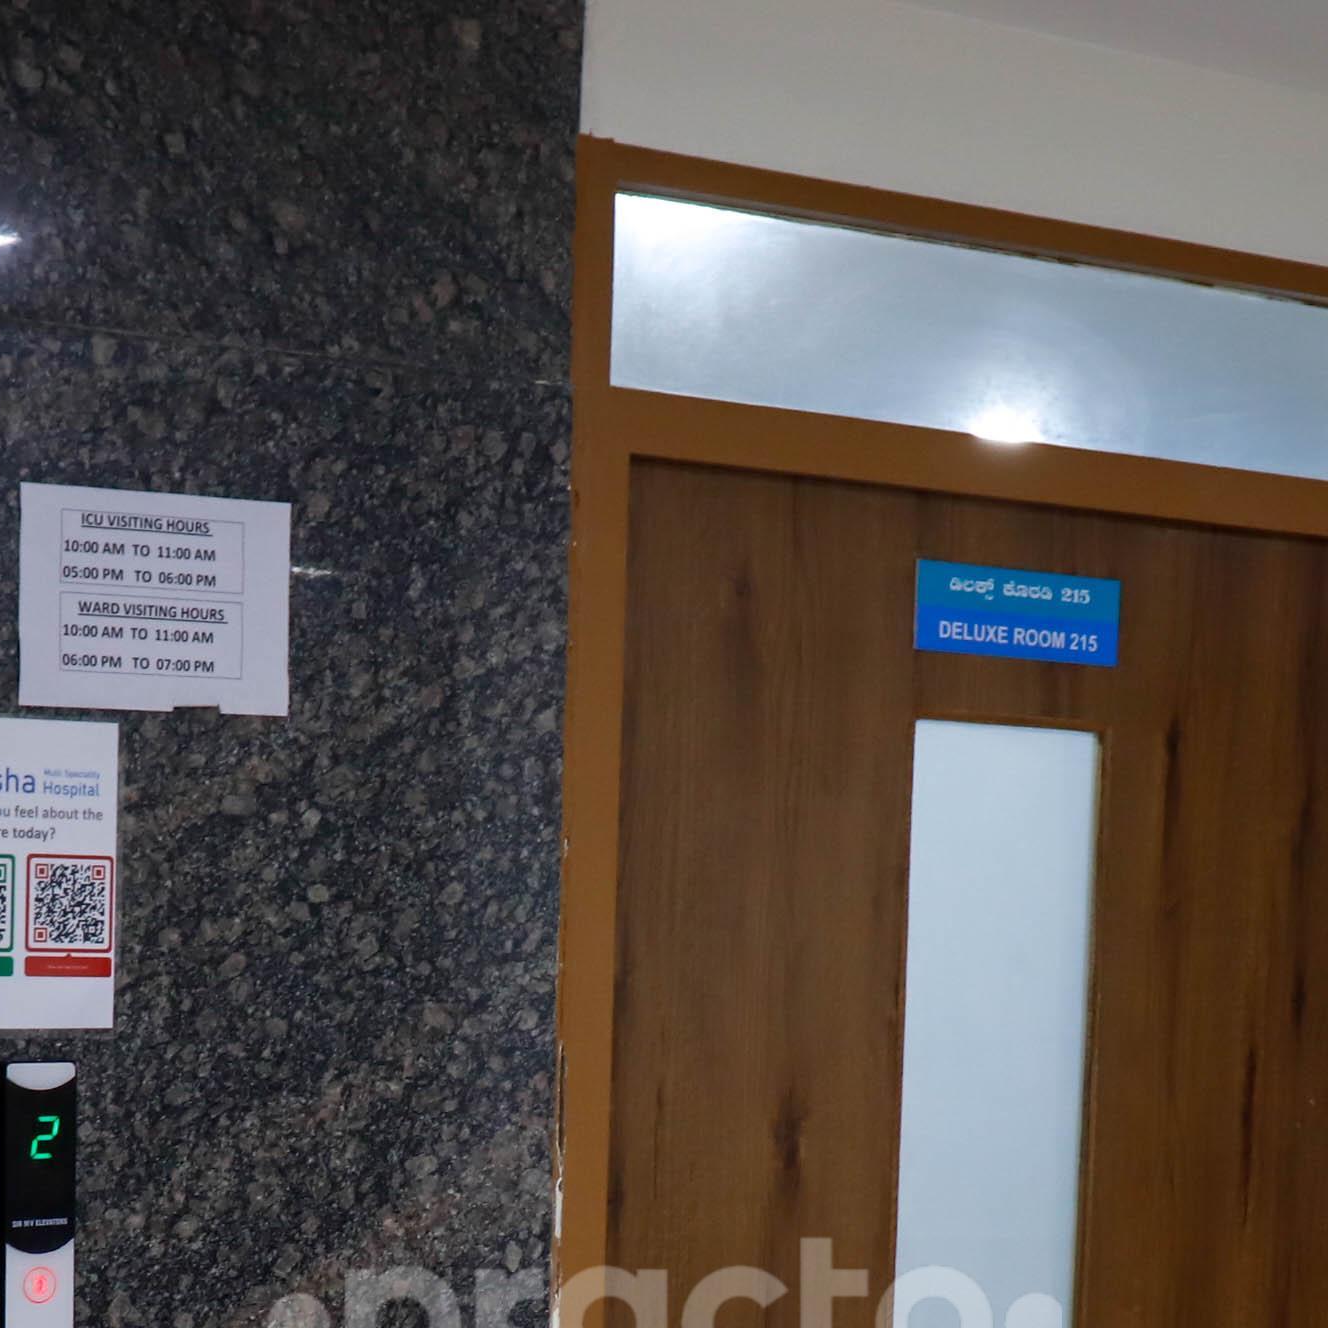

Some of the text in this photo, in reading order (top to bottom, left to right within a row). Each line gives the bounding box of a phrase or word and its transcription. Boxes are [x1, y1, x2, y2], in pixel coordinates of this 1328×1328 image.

[81, 513, 210, 534] ICU VISITING HOURS
[64, 539, 216, 562] 10:00 AM TO 11:00 AM
[63, 565, 216, 587] 05:00 PM TO 06:00 PM
[1060, 586, 1091, 605] 215
[78, 600, 225, 621] WARD VISITING HOURS
[63, 624, 214, 644] 10:00 AM TO 11:00 AM
[938, 620, 1098, 652] DELUXE ROOM 215
[62, 653, 215, 673] 06:00 PM TO 07:00 PM
[43, 781, 100, 798] Hospital
[14, 804, 39, 819] feel
[42, 805, 80, 821] about
[82, 807, 104, 822] the
[13, 825, 56, 841] today?
[30, 1115, 61, 1160] 2
